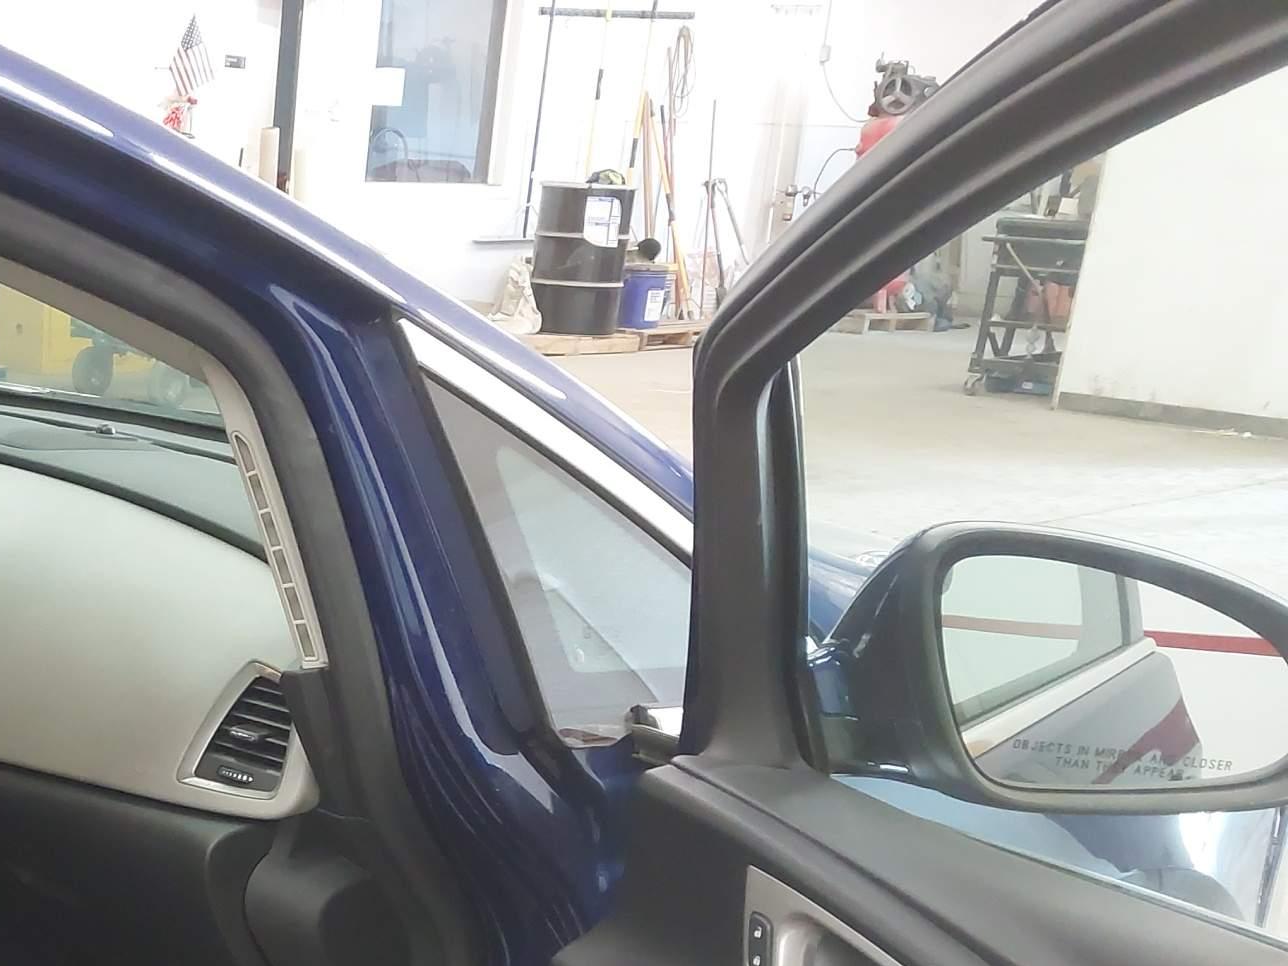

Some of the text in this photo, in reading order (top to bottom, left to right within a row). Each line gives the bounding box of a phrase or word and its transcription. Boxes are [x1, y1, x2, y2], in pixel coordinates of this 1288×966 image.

[1012, 739, 1072, 754] OBJECTS
[1077, 745, 1090, 756] IN
[1183, 756, 1233, 771] CLOSER
[1055, 756, 1090, 769] THAN
